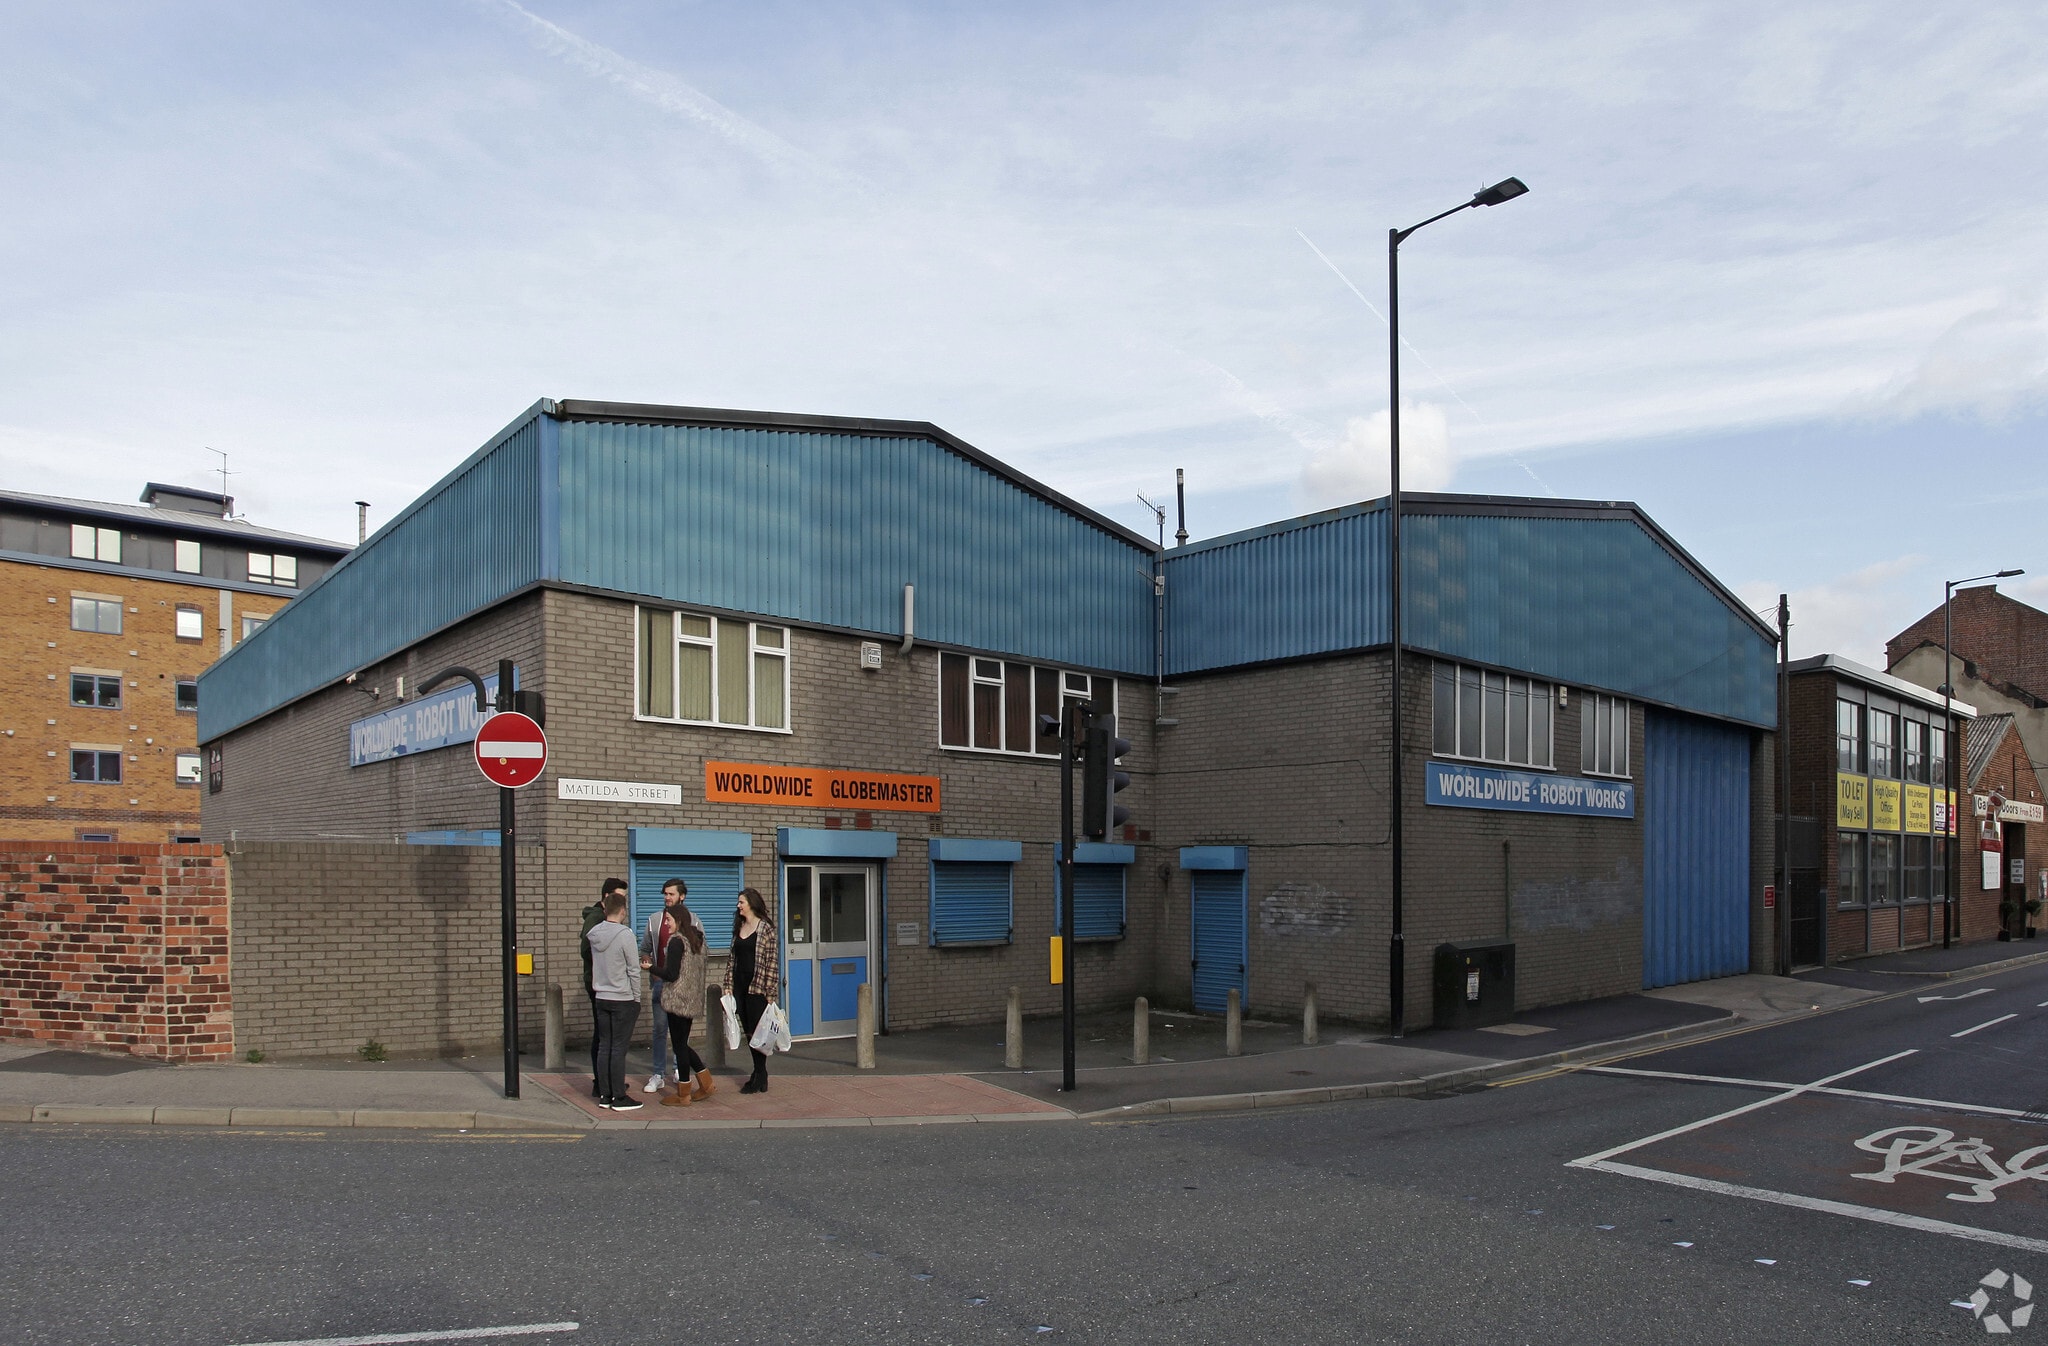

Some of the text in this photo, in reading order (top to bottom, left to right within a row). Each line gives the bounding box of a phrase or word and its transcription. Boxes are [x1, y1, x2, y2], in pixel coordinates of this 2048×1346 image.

[354, 714, 408, 759] WORLDWIDE
[415, 700, 455, 742] ROBOT
[565, 784, 620, 796] MATILDA
[628, 787, 669, 799] STREET
[714, 772, 933, 803] WORLDWIDE GLOBEMASTER
[1439, 773, 1626, 810] WORLDWIDE ROBOT WORKS
[1841, 780, 1864, 800] TO LET
[1875, 785, 1898, 800] High Quality
[1840, 804, 1853, 822] (May
[1853, 806, 1865, 822] Sell)
[1880, 801, 1893, 813] Offices
